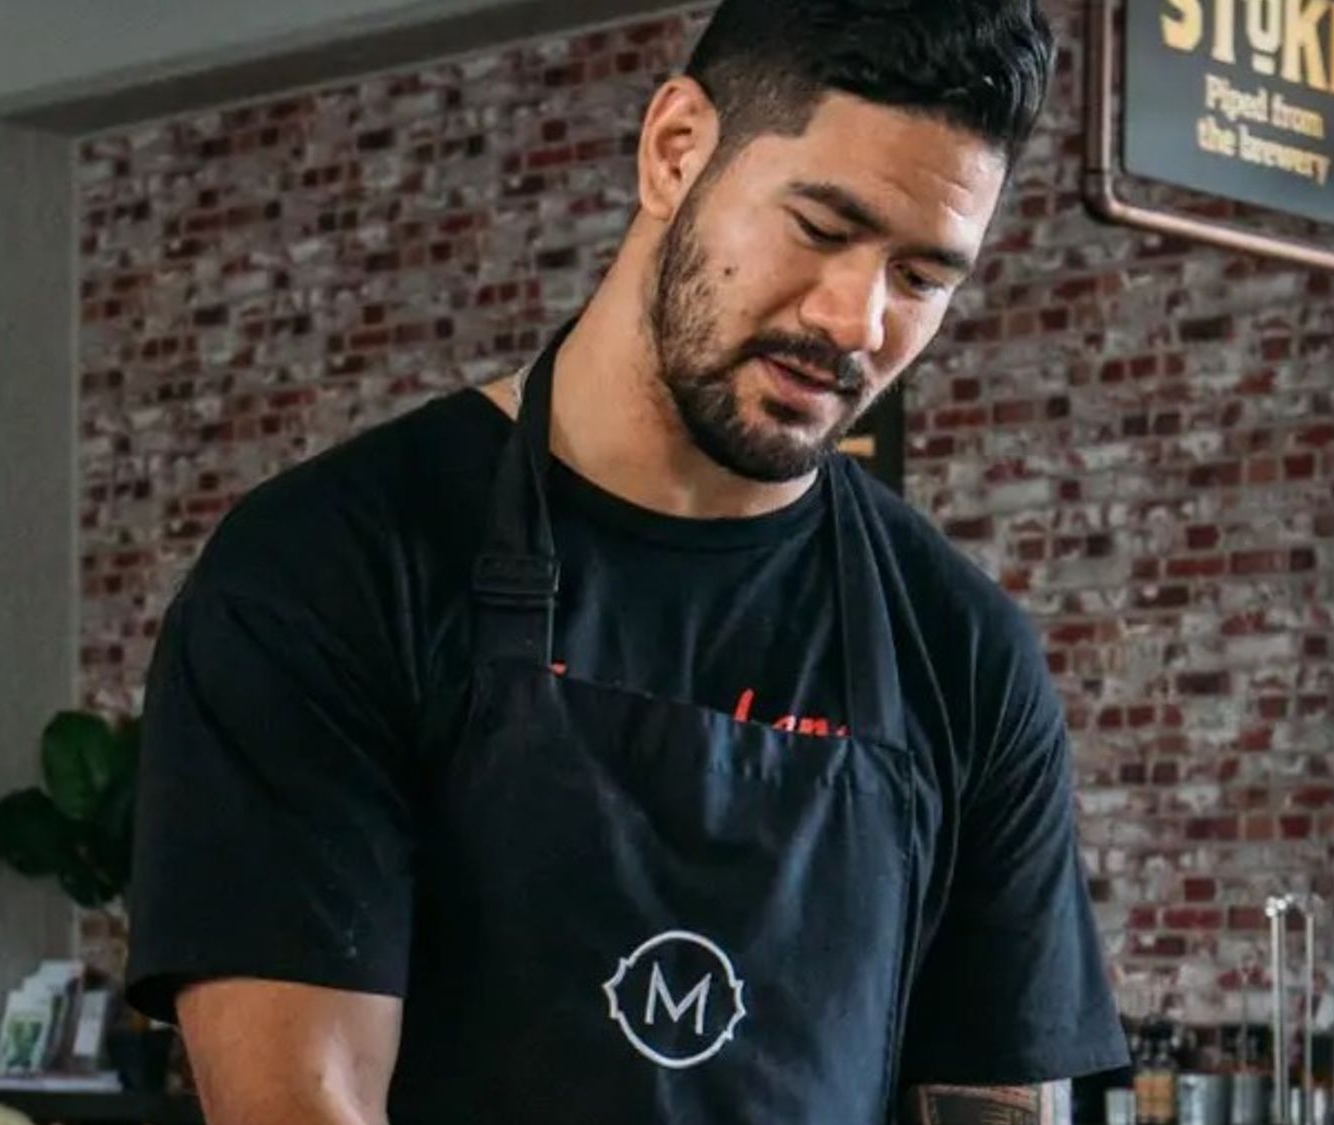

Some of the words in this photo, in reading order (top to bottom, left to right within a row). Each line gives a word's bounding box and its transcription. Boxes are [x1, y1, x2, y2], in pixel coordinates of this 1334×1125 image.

[1205, 73, 1268, 122] Piped
[1272, 92, 1324, 138] from
[1196, 115, 1236, 156] the
[1238, 123, 1330, 186] brewery
[645, 961, 712, 1036] M
